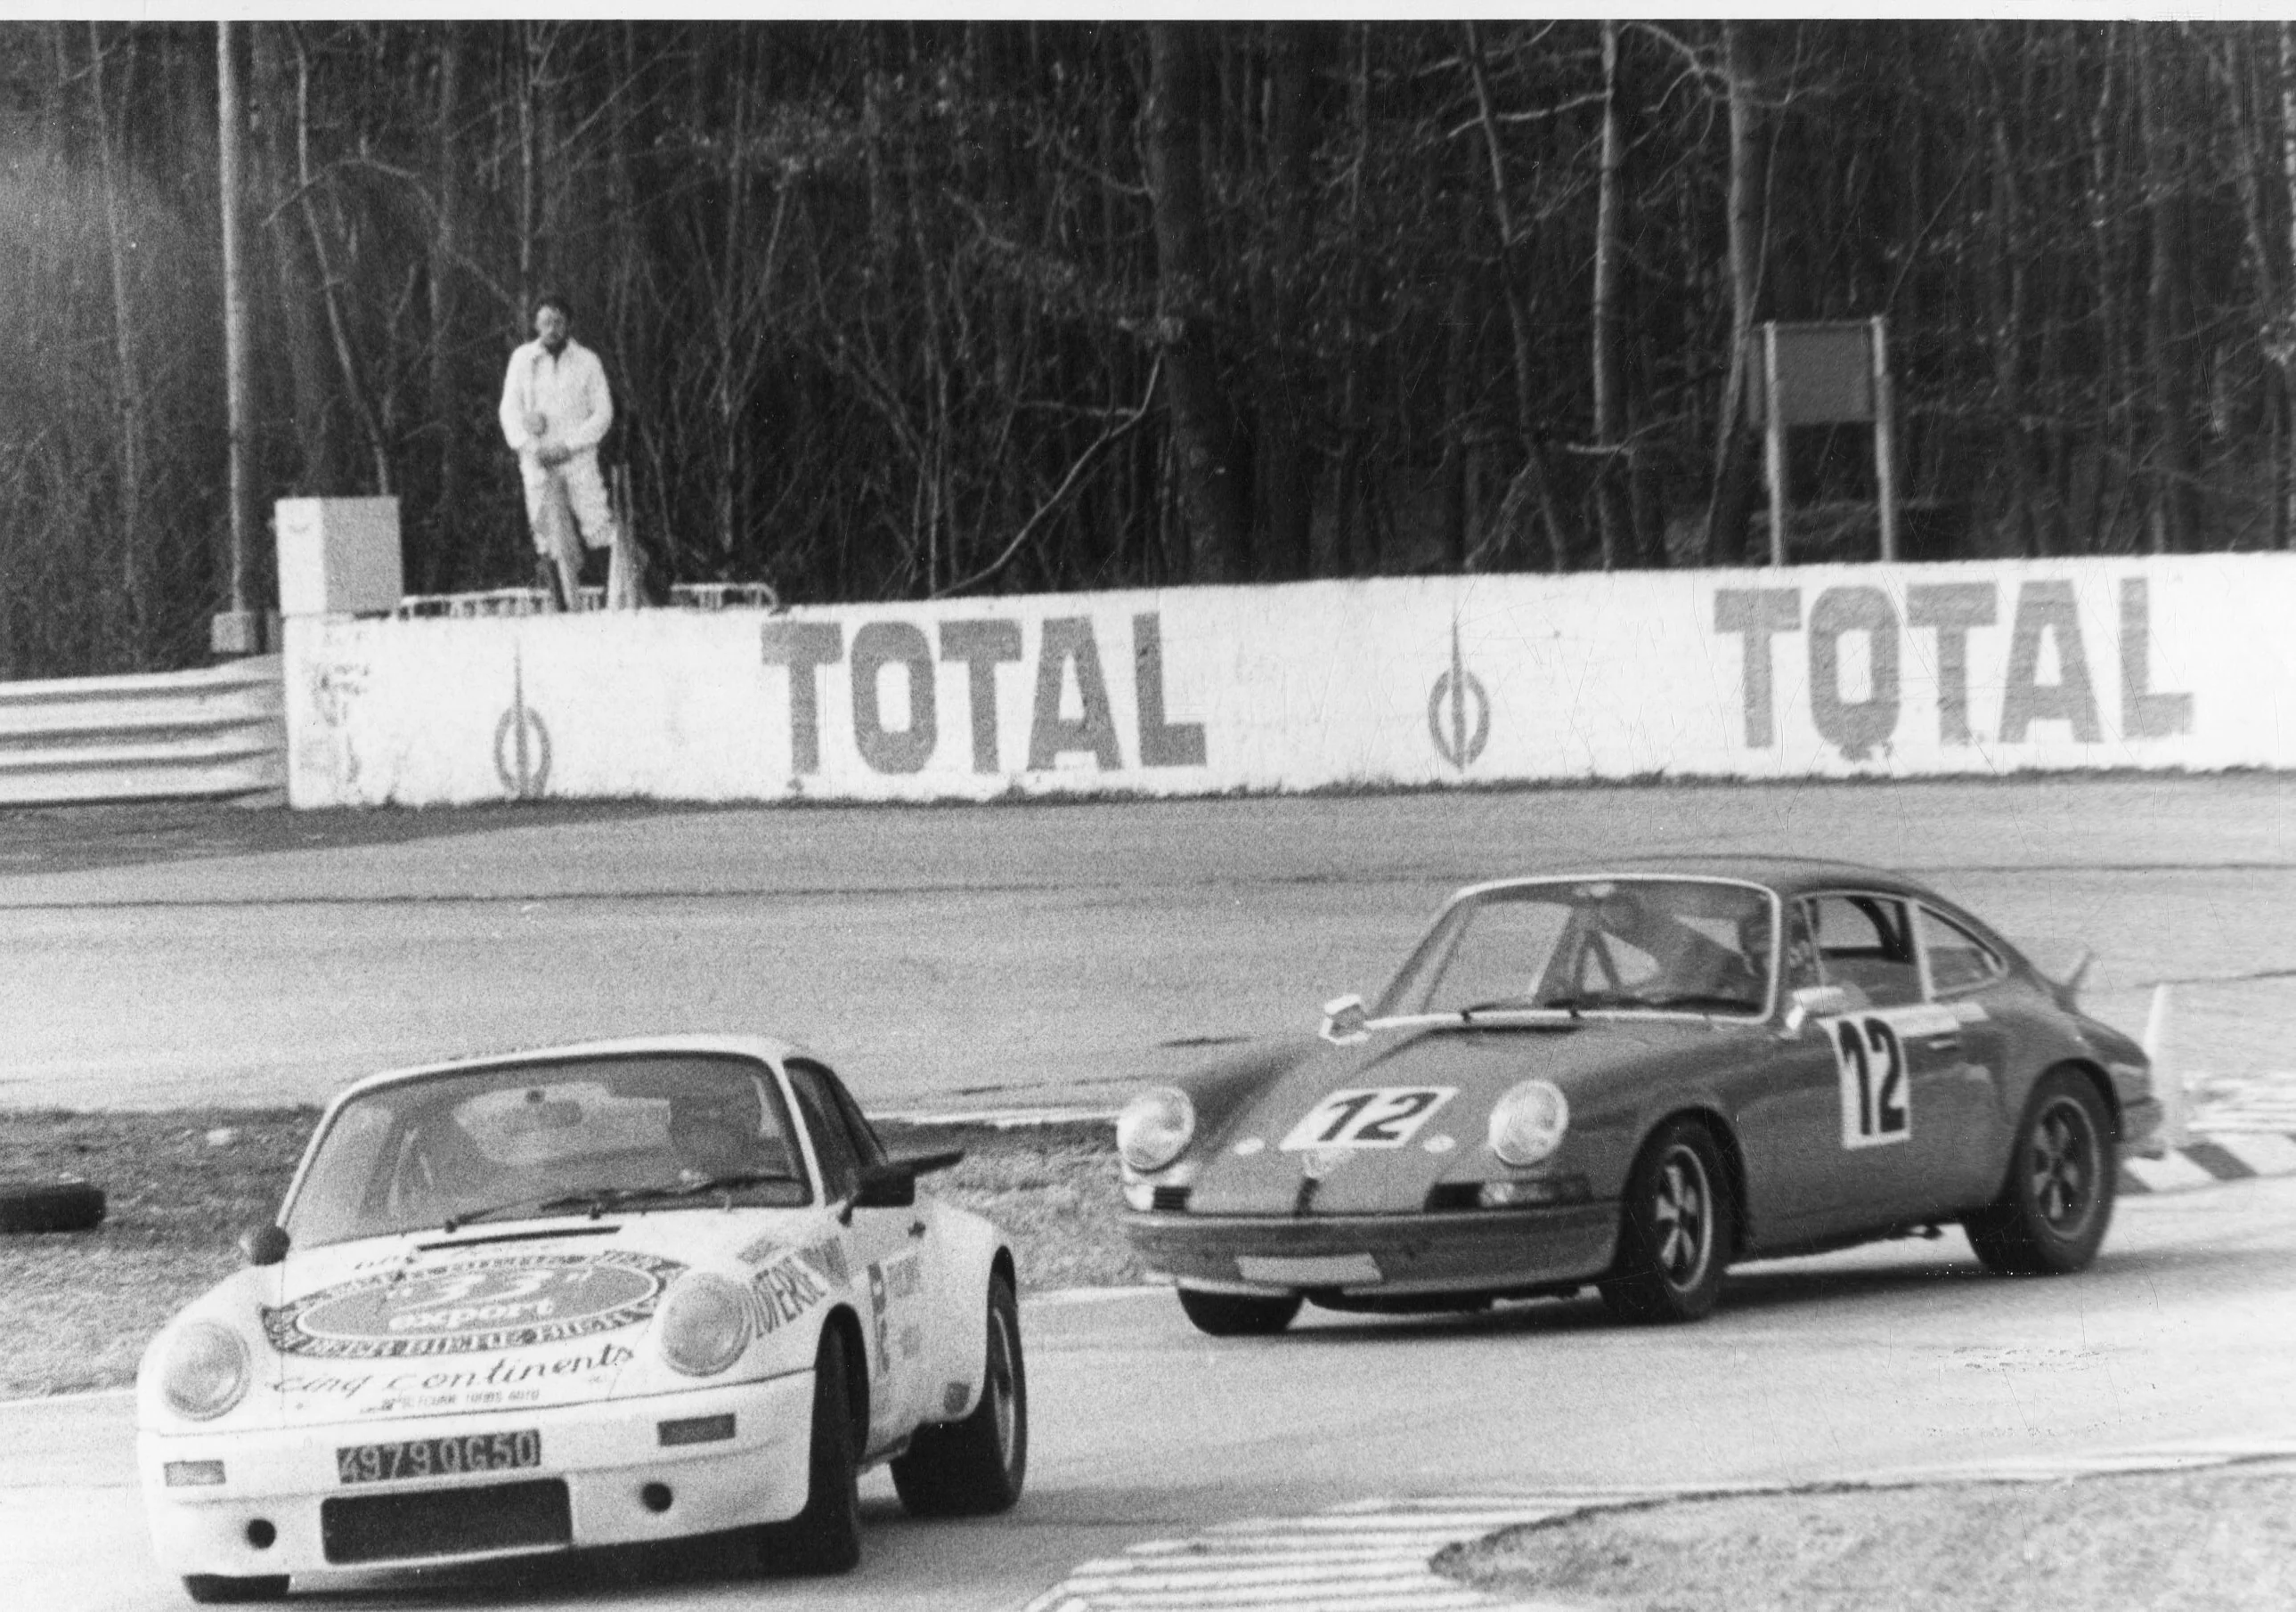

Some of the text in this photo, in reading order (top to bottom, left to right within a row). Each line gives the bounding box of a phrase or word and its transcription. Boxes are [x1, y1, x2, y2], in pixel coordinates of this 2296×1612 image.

[761, 612, 1207, 774] TOTAL
[1714, 577, 2194, 748] TOTAL
[1317, 1092, 1438, 1143] 12
[1838, 1017, 1906, 1136] 12
[389, 1298, 554, 1331] export
